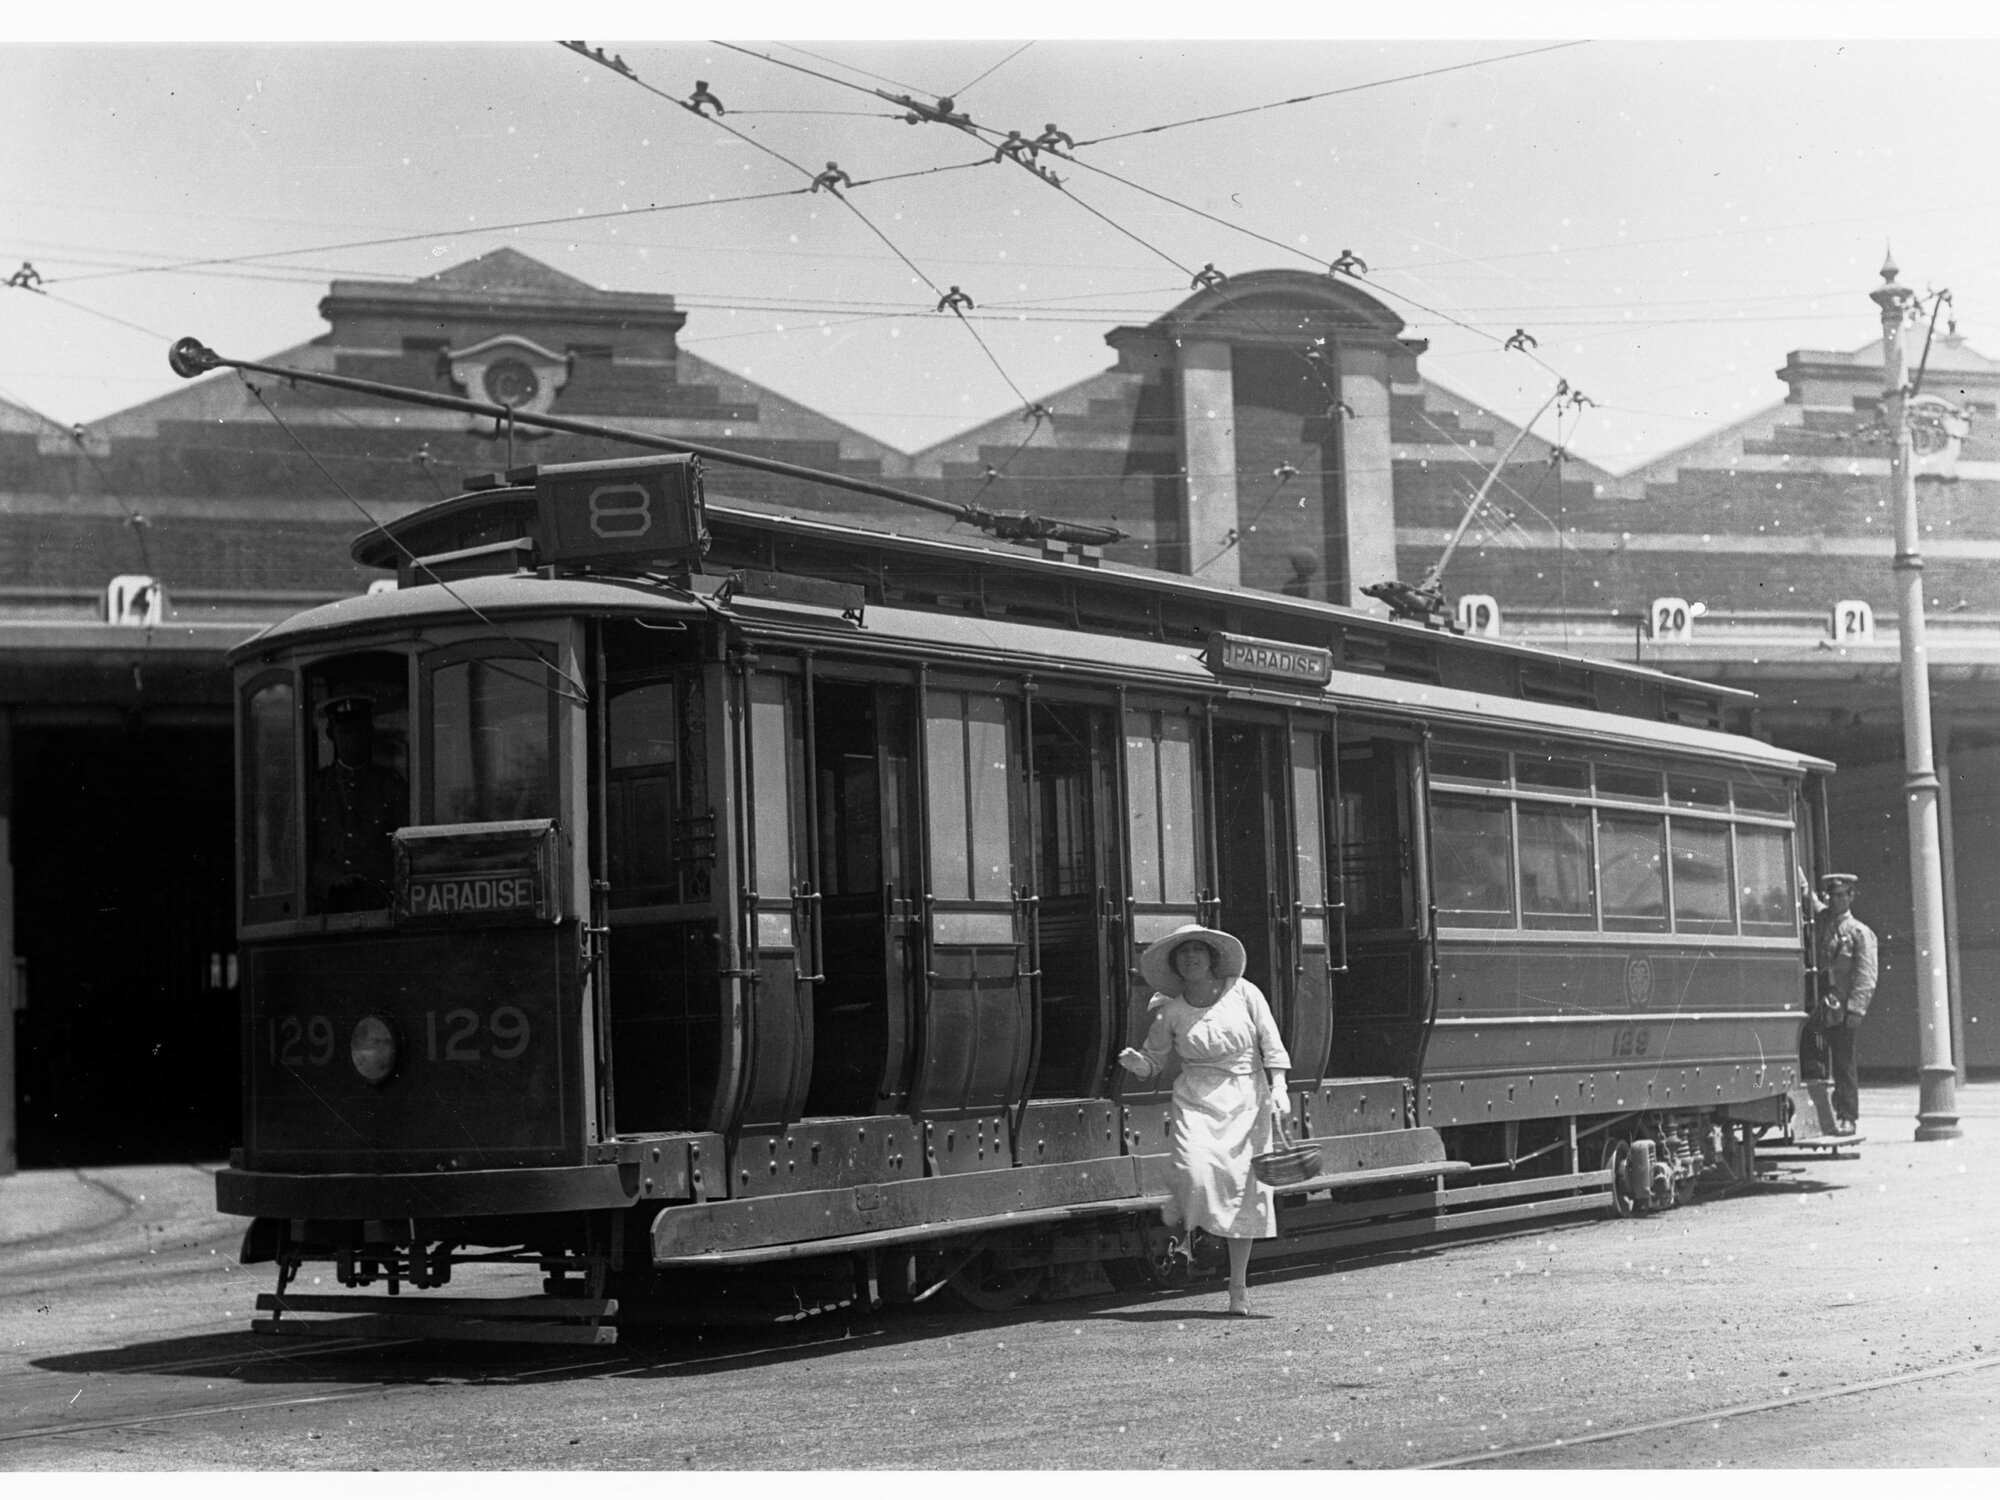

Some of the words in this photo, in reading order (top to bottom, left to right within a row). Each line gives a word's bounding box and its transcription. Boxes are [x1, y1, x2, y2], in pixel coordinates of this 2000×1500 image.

[588, 483, 652, 538] 8
[1659, 607, 1685, 632] 20
[1845, 610, 1865, 633] 21
[1234, 647, 1319, 675] PARADISE
[410, 878, 532, 913] PARADISE
[269, 1014, 335, 1066] 129
[426, 1005, 531, 1061] 129
